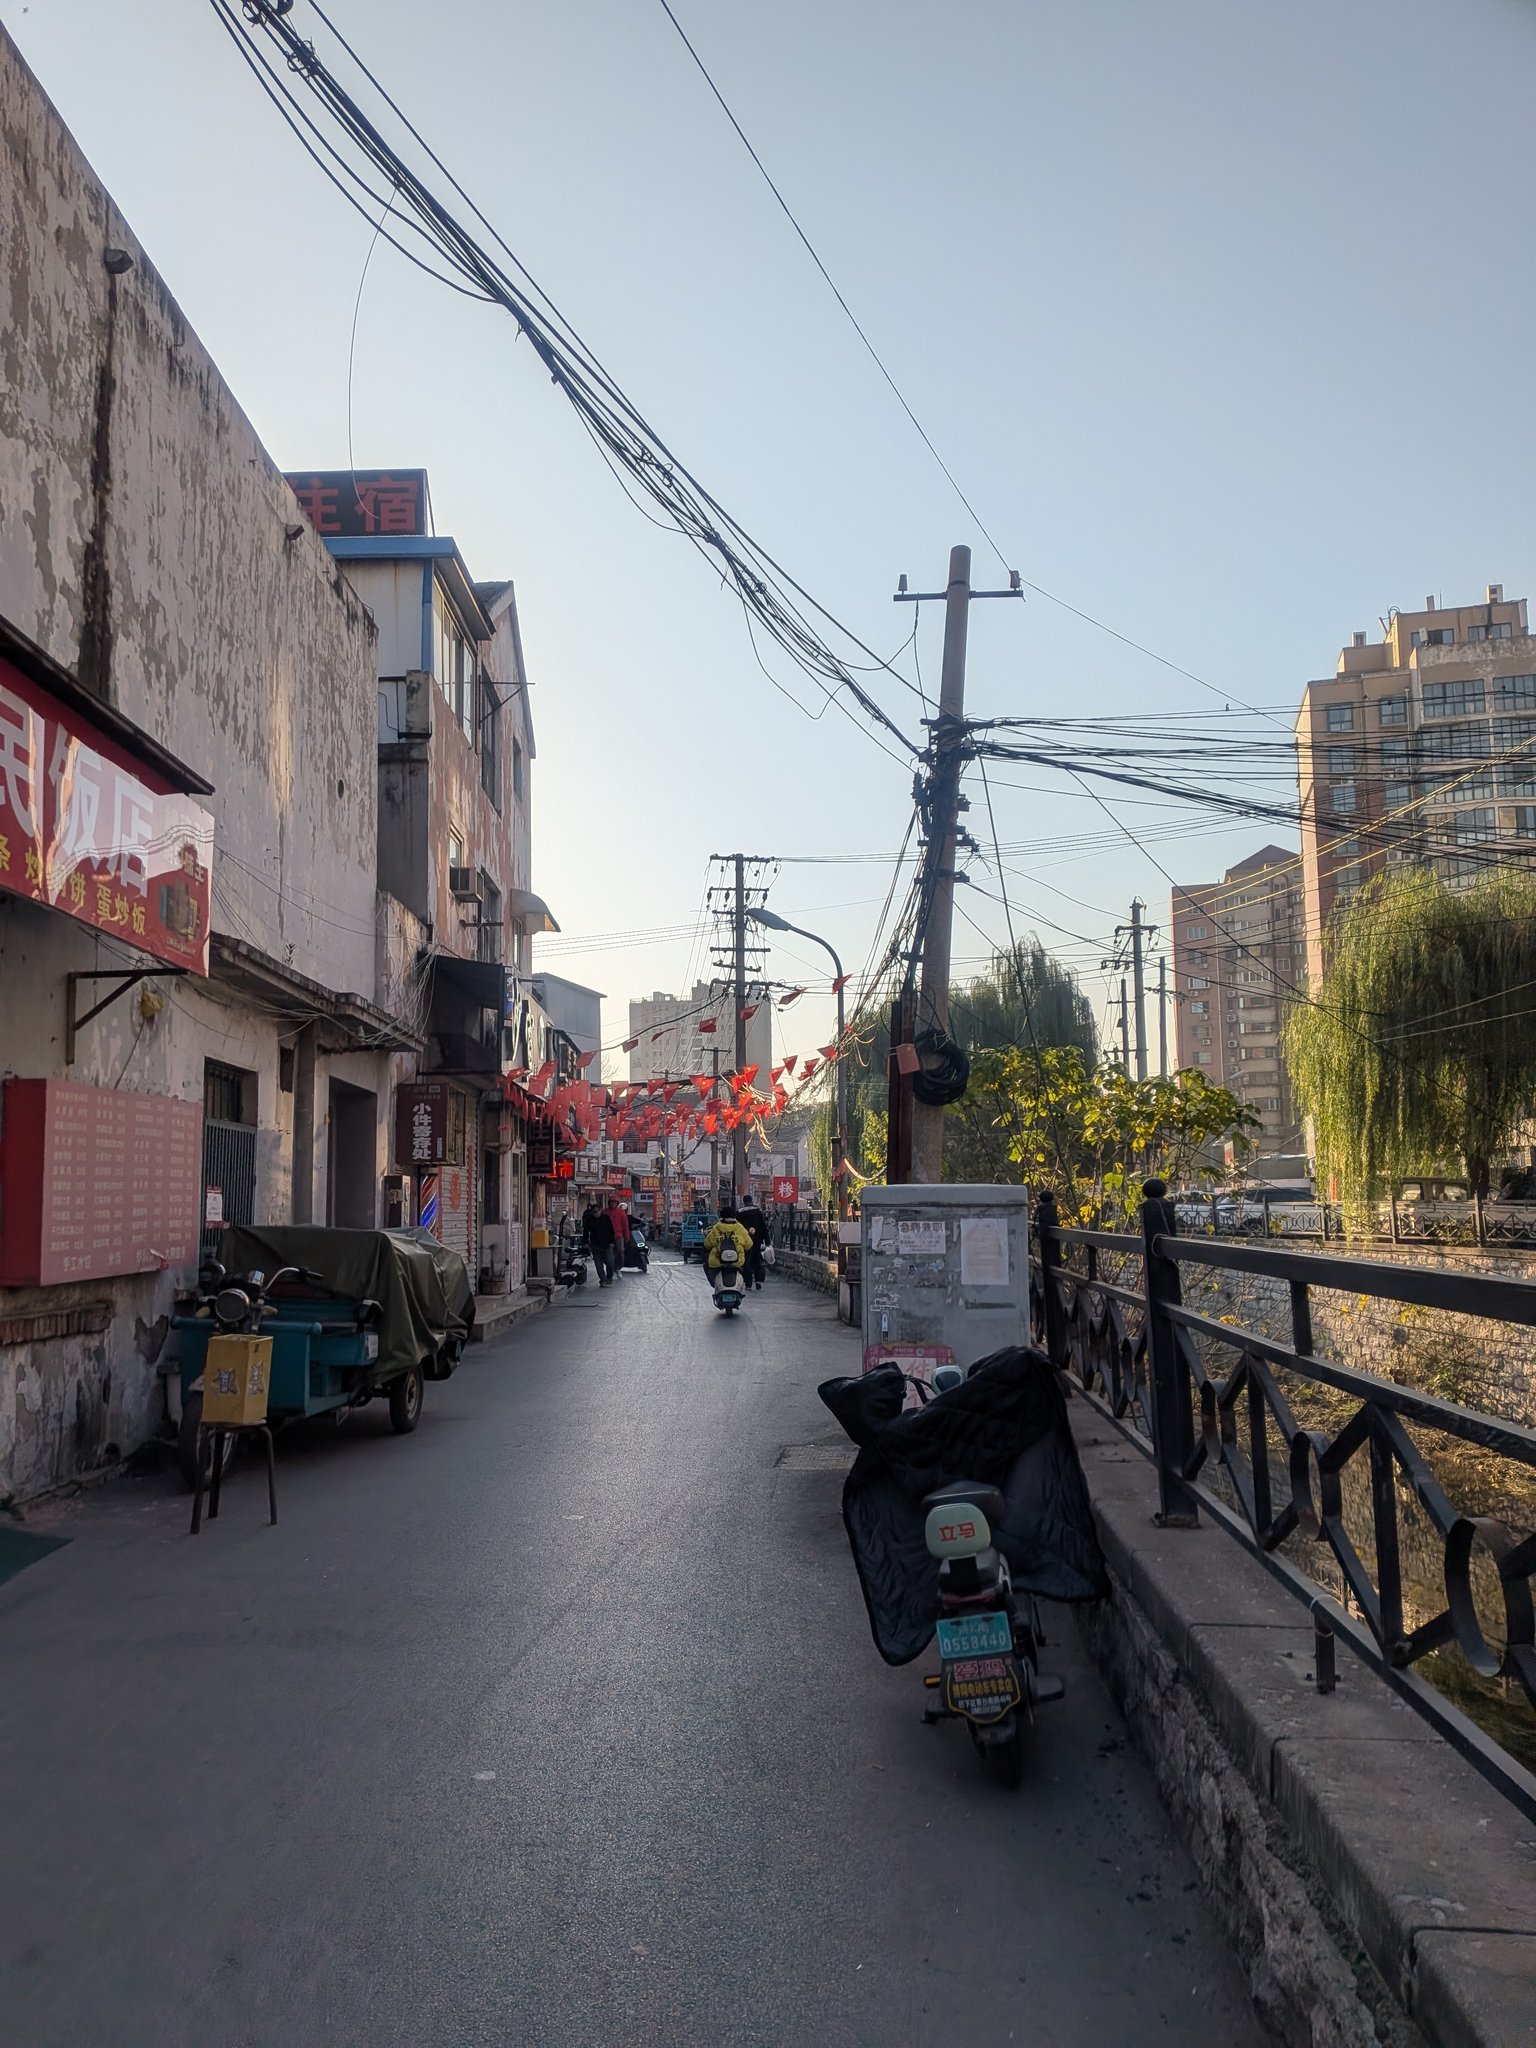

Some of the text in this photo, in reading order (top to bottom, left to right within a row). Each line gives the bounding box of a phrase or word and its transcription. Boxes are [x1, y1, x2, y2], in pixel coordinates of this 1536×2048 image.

[288, 474, 419, 533] 住宿
[97, 884, 146, 936] 蛋炒饭
[412, 1102, 432, 1160] 小件寄存处
[938, 1521, 977, 1542] 立马
